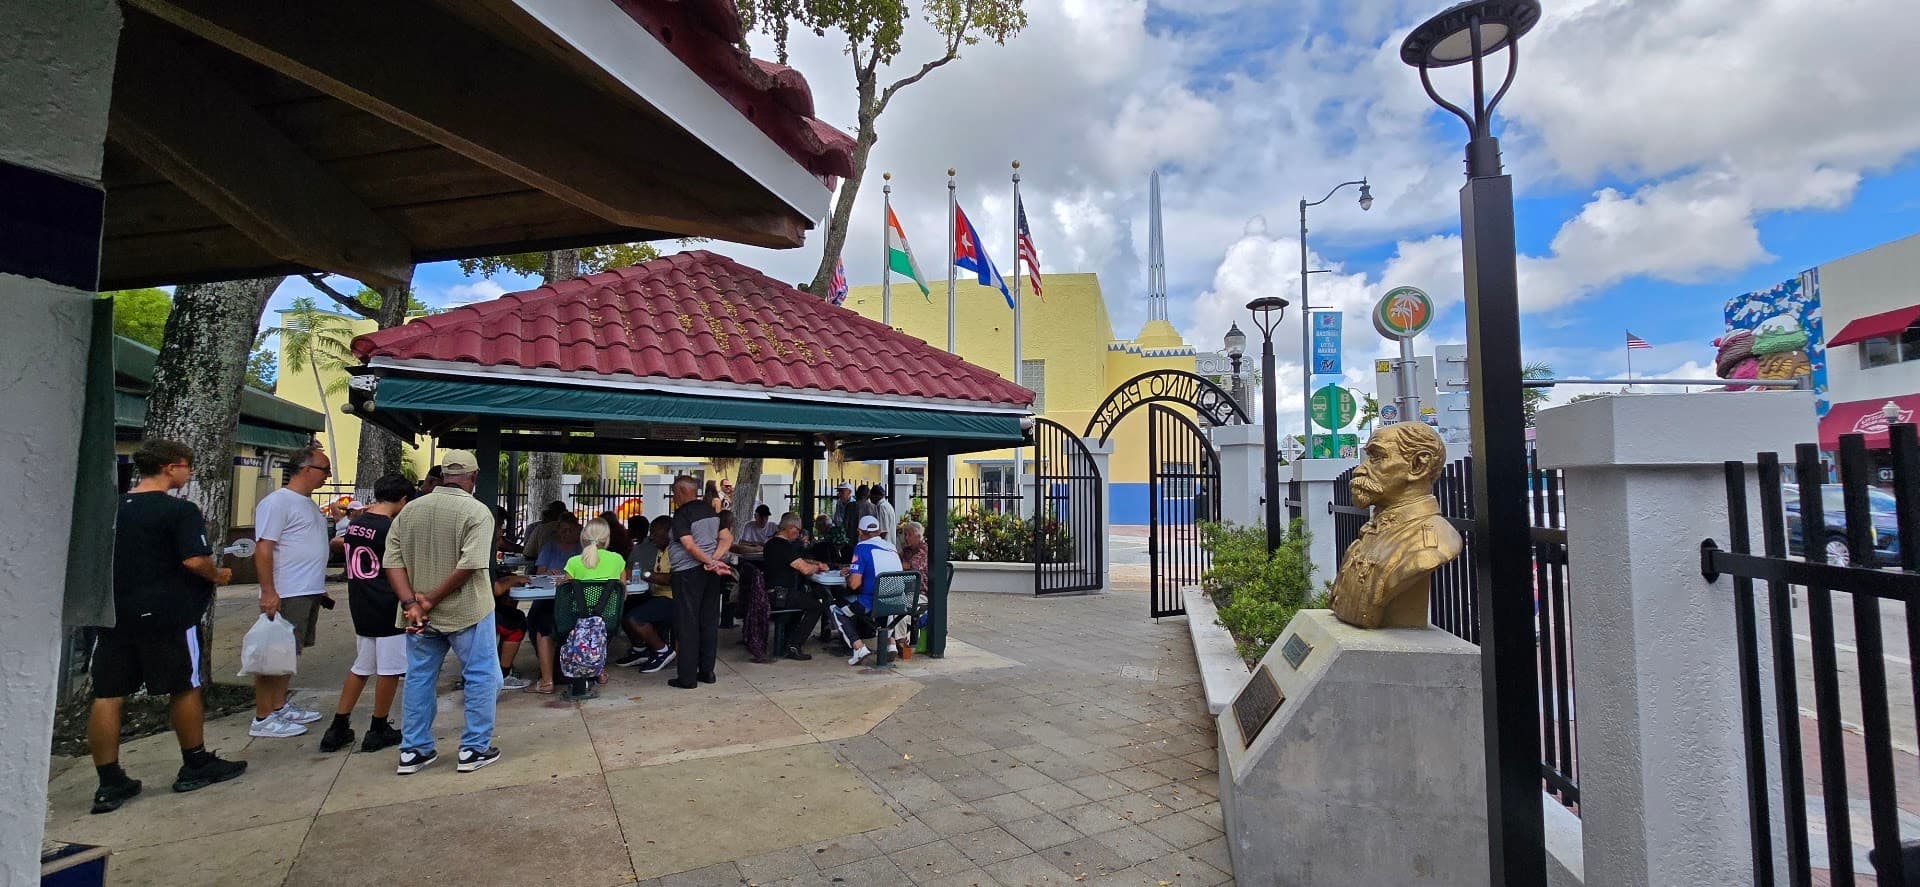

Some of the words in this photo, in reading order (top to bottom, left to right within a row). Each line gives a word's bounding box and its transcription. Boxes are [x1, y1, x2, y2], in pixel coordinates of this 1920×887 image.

[1195, 358, 1250, 373] TOWR
[1341, 393, 1351, 423] BUS
[346, 524, 377, 540] MESSI
[343, 542, 380, 580] 10
